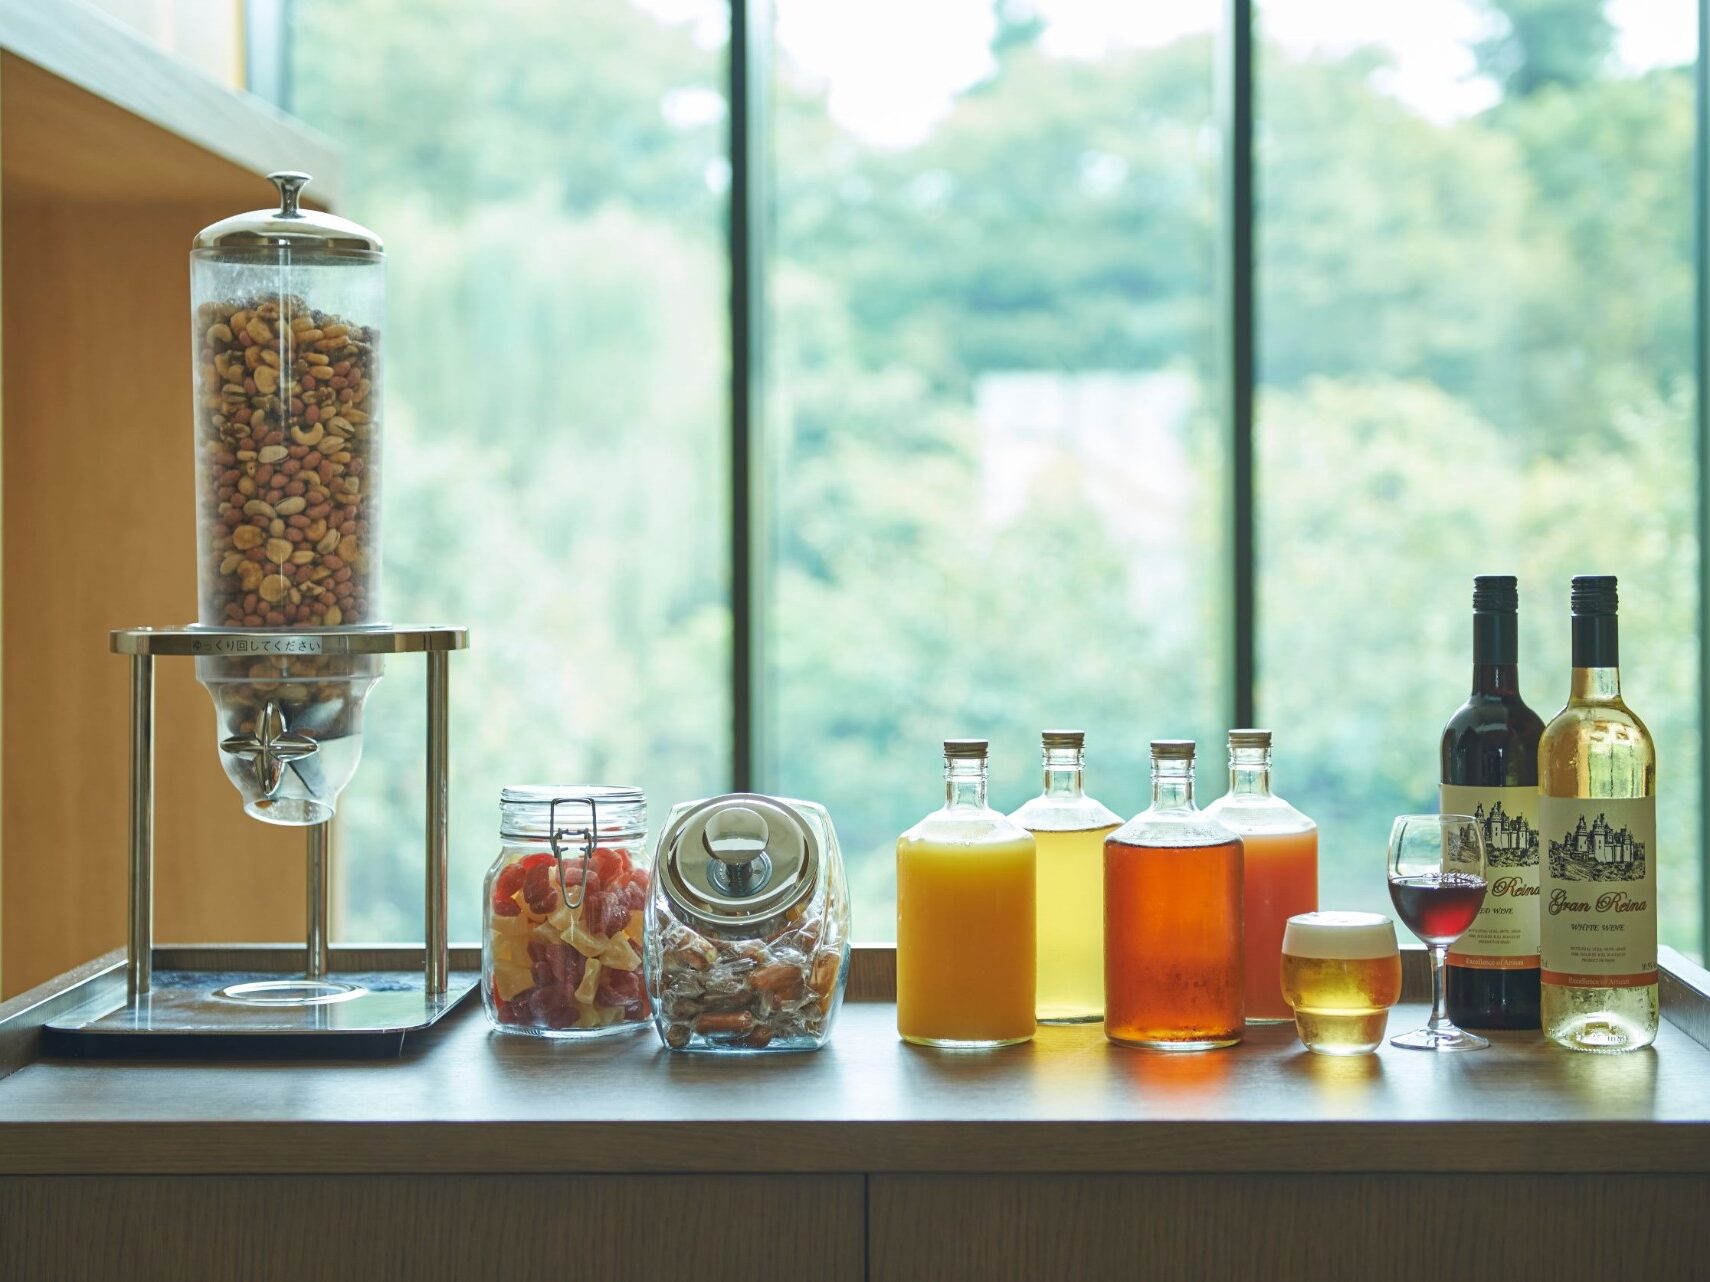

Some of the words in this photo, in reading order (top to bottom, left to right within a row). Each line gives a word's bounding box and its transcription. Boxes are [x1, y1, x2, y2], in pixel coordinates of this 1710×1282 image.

[192, 640, 321, 652] ゆっくり回してください
[1492, 876, 1540, 897] Reina
[1548, 888, 1591, 916] Gran
[1595, 891, 1647, 913] Reina
[1571, 923, 1599, 931] WHITE
[1601, 923, 1625, 931] WINE
